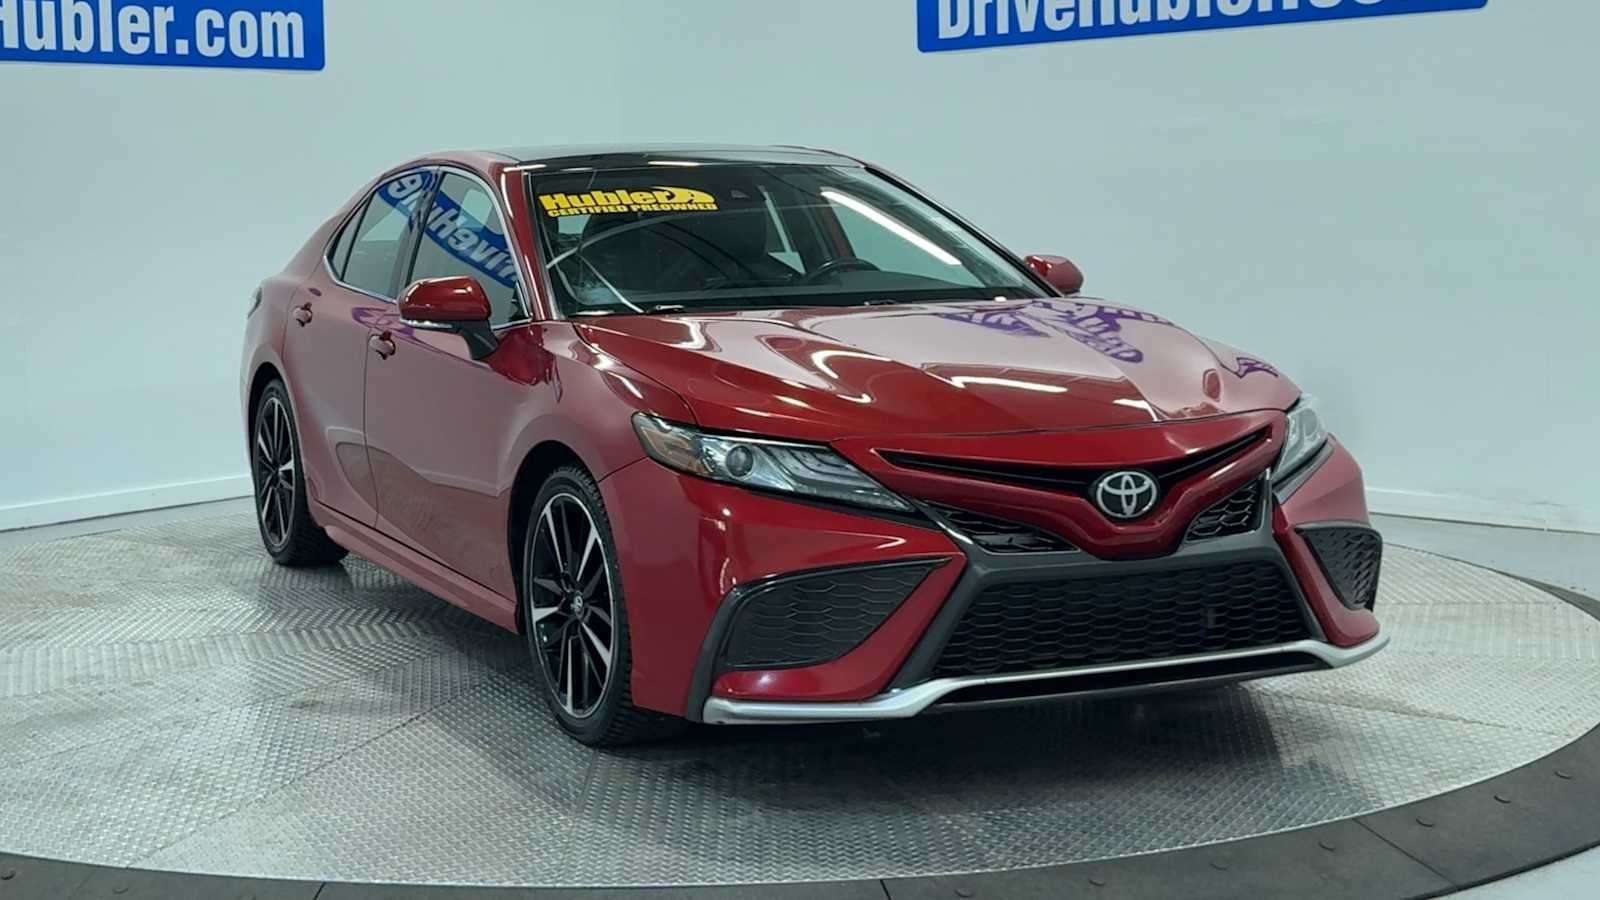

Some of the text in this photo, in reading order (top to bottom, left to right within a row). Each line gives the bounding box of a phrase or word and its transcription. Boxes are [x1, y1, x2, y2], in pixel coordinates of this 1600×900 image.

[538, 189, 670, 211] Hubler
[547, 202, 718, 217] CERTIFIED PREOWNED
